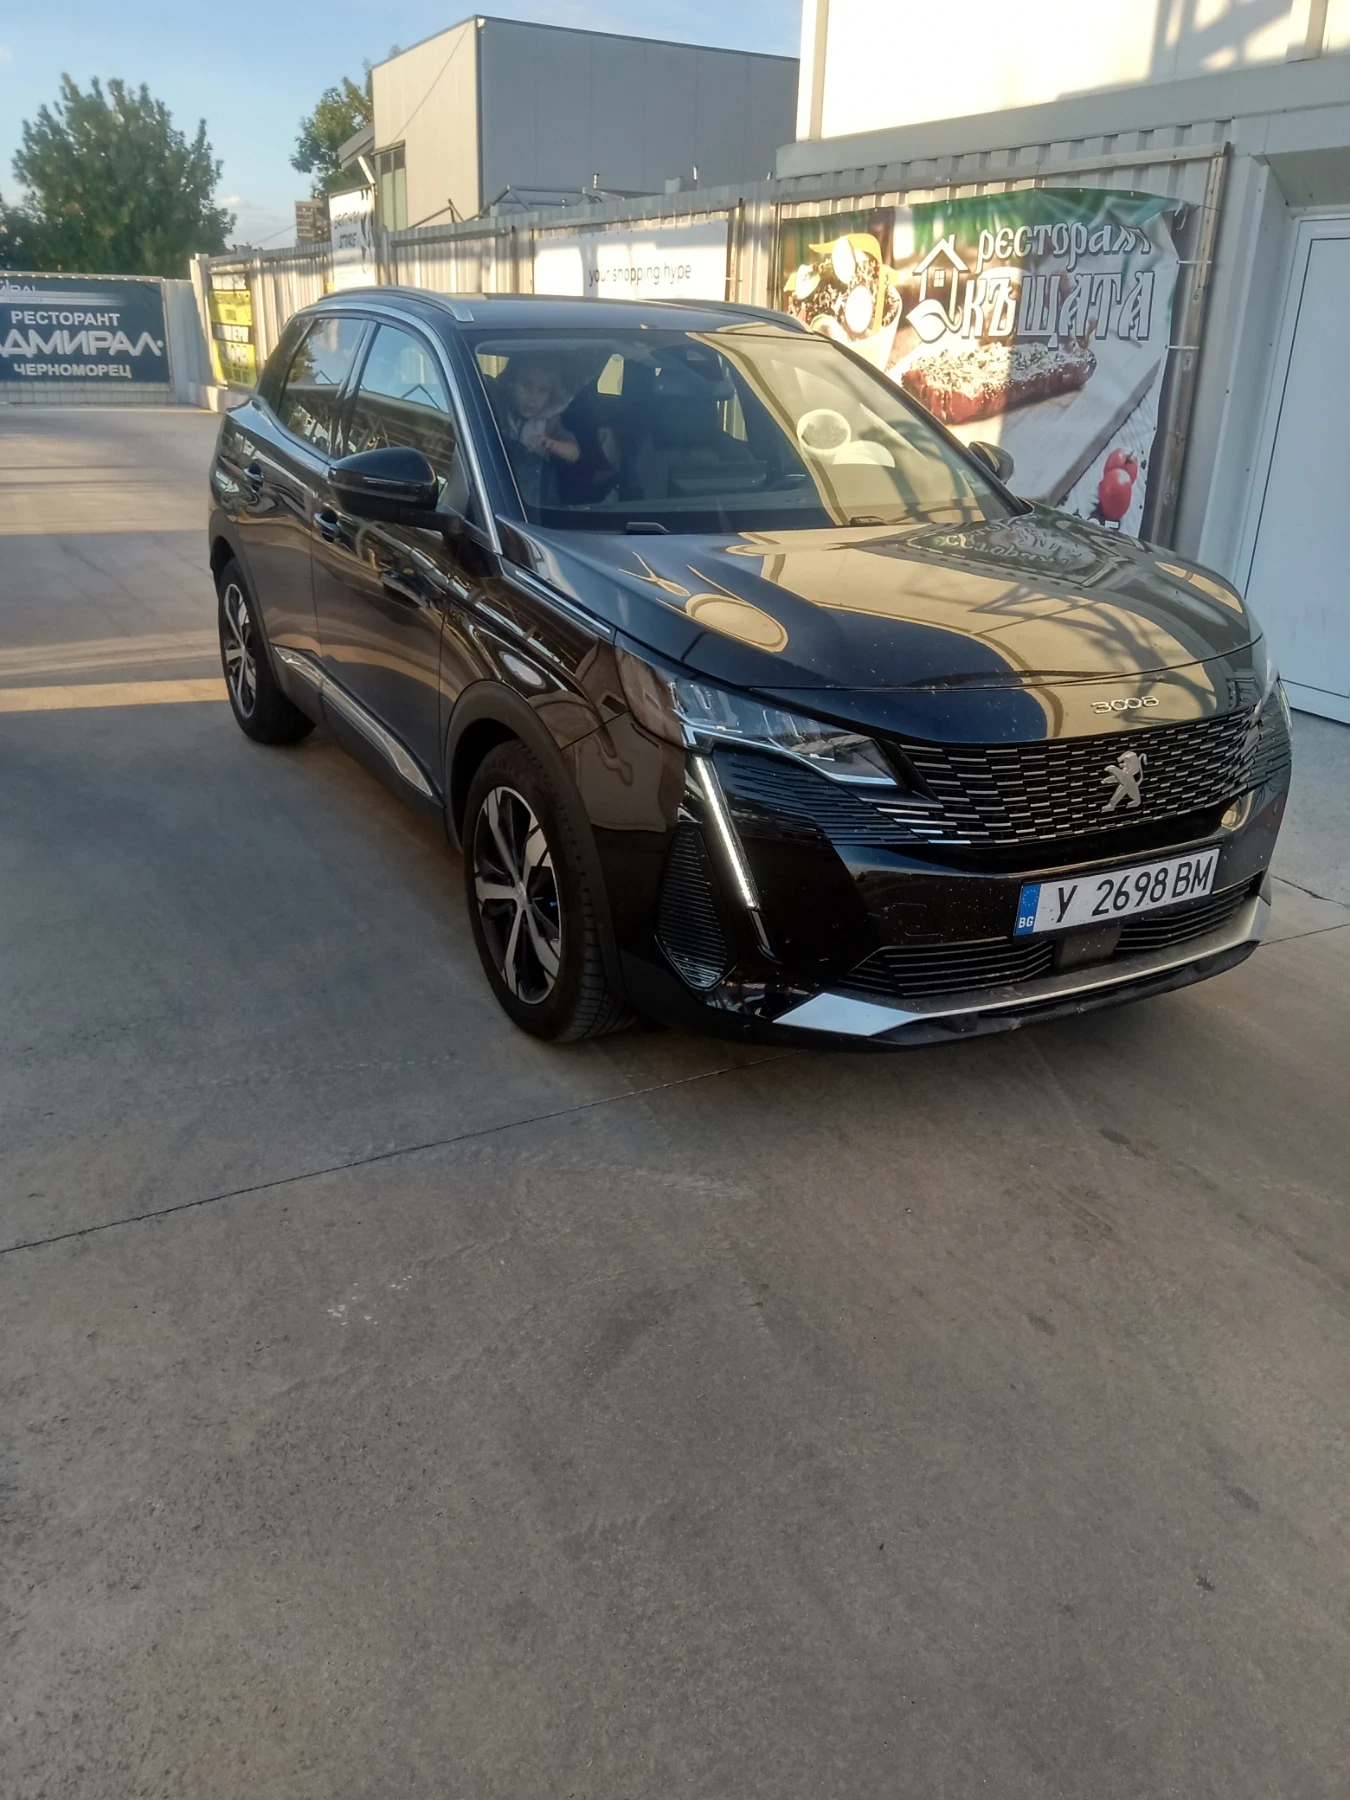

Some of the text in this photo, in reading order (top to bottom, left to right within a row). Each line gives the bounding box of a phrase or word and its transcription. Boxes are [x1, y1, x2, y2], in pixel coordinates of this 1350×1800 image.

[613, 265, 660, 285] shopping
[664, 262, 692, 285] hype
[10, 310, 120, 326] РЕСТОРАНТ
[0, 328, 162, 358] ДМИРАЛ
[13, 363, 132, 378] ЧЕРНОМОРЕЦ
[1091, 695, 1160, 714] 3008
[1091, 867, 1169, 917] 2698
[1018, 915, 1034, 929] BG
